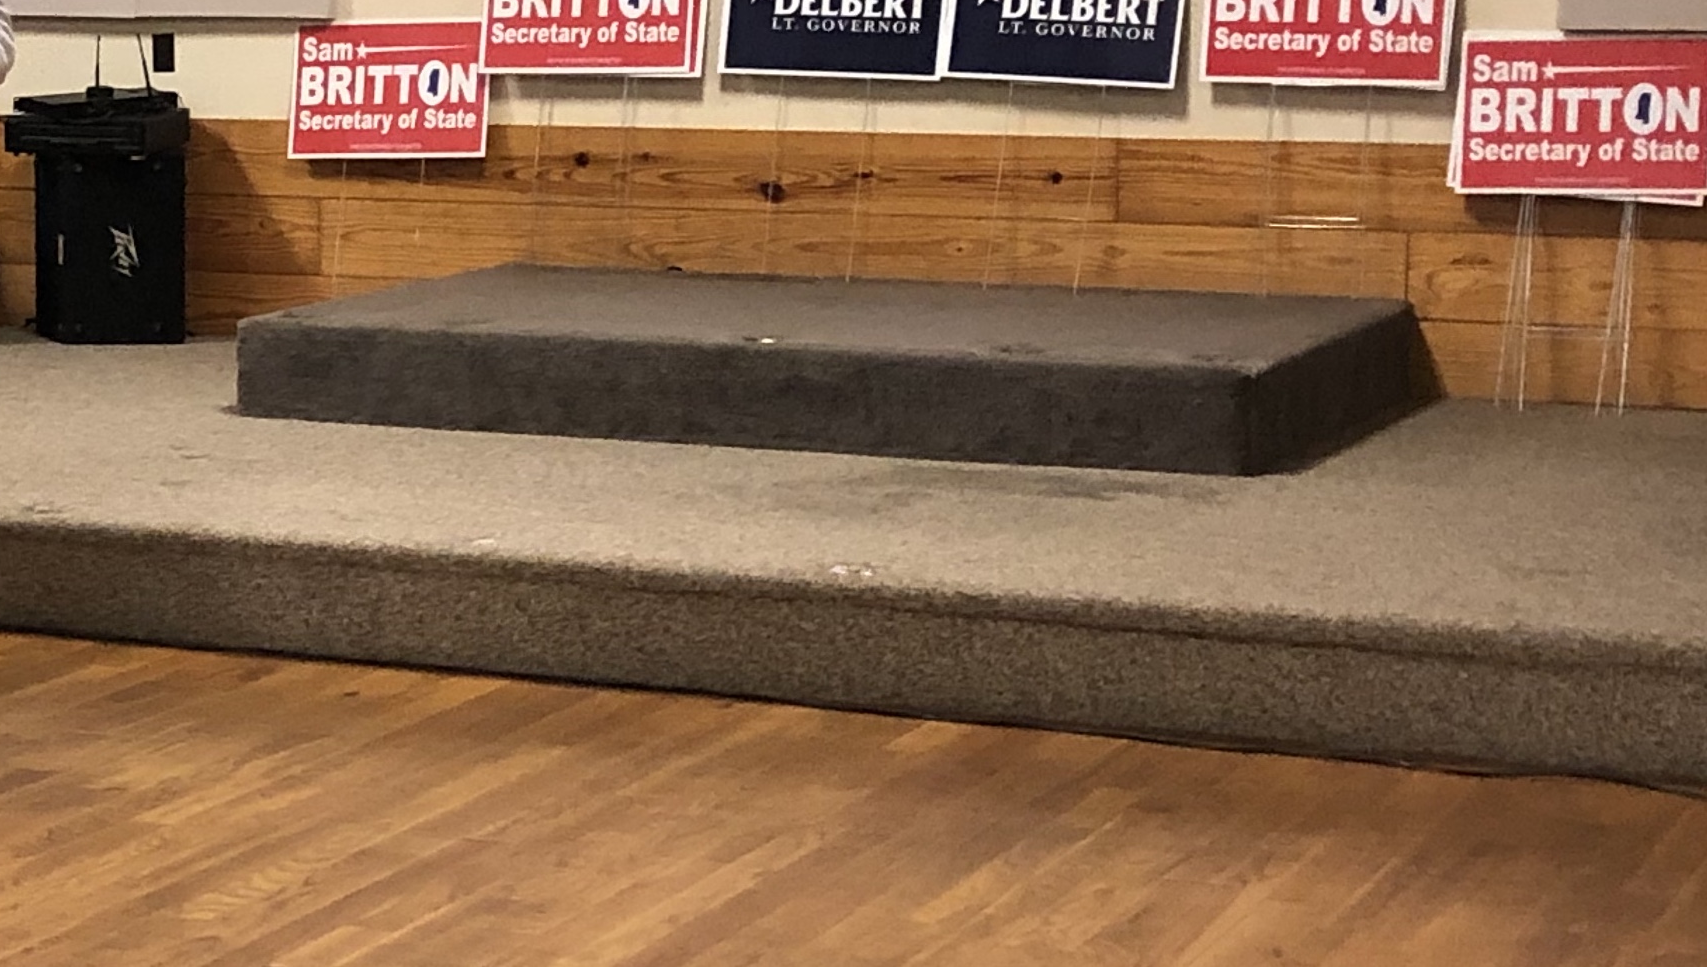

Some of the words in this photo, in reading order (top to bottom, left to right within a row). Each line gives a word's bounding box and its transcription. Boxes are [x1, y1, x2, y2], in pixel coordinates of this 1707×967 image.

[491, 22, 592, 48] Secretary
[597, 21, 619, 43] of
[624, 21, 680, 43] State
[806, 18, 921, 34] GOVERNOR
[1035, 22, 1155, 41] GOVERNOR
[302, 36, 353, 62] Sam
[1214, 26, 1331, 58] Secretary
[1337, 29, 1362, 52] of
[1368, 29, 1433, 53] State
[1472, 54, 1538, 83] Sam
[299, 60, 478, 106] BRITTON
[298, 110, 393, 134] Secretary
[398, 108, 419, 129] of
[423, 108, 477, 129] State
[1469, 83, 1701, 135] BRITTON
[1468, 137, 1591, 167] Secretary
[1598, 138, 1624, 161] of
[1631, 138, 1700, 161] State
